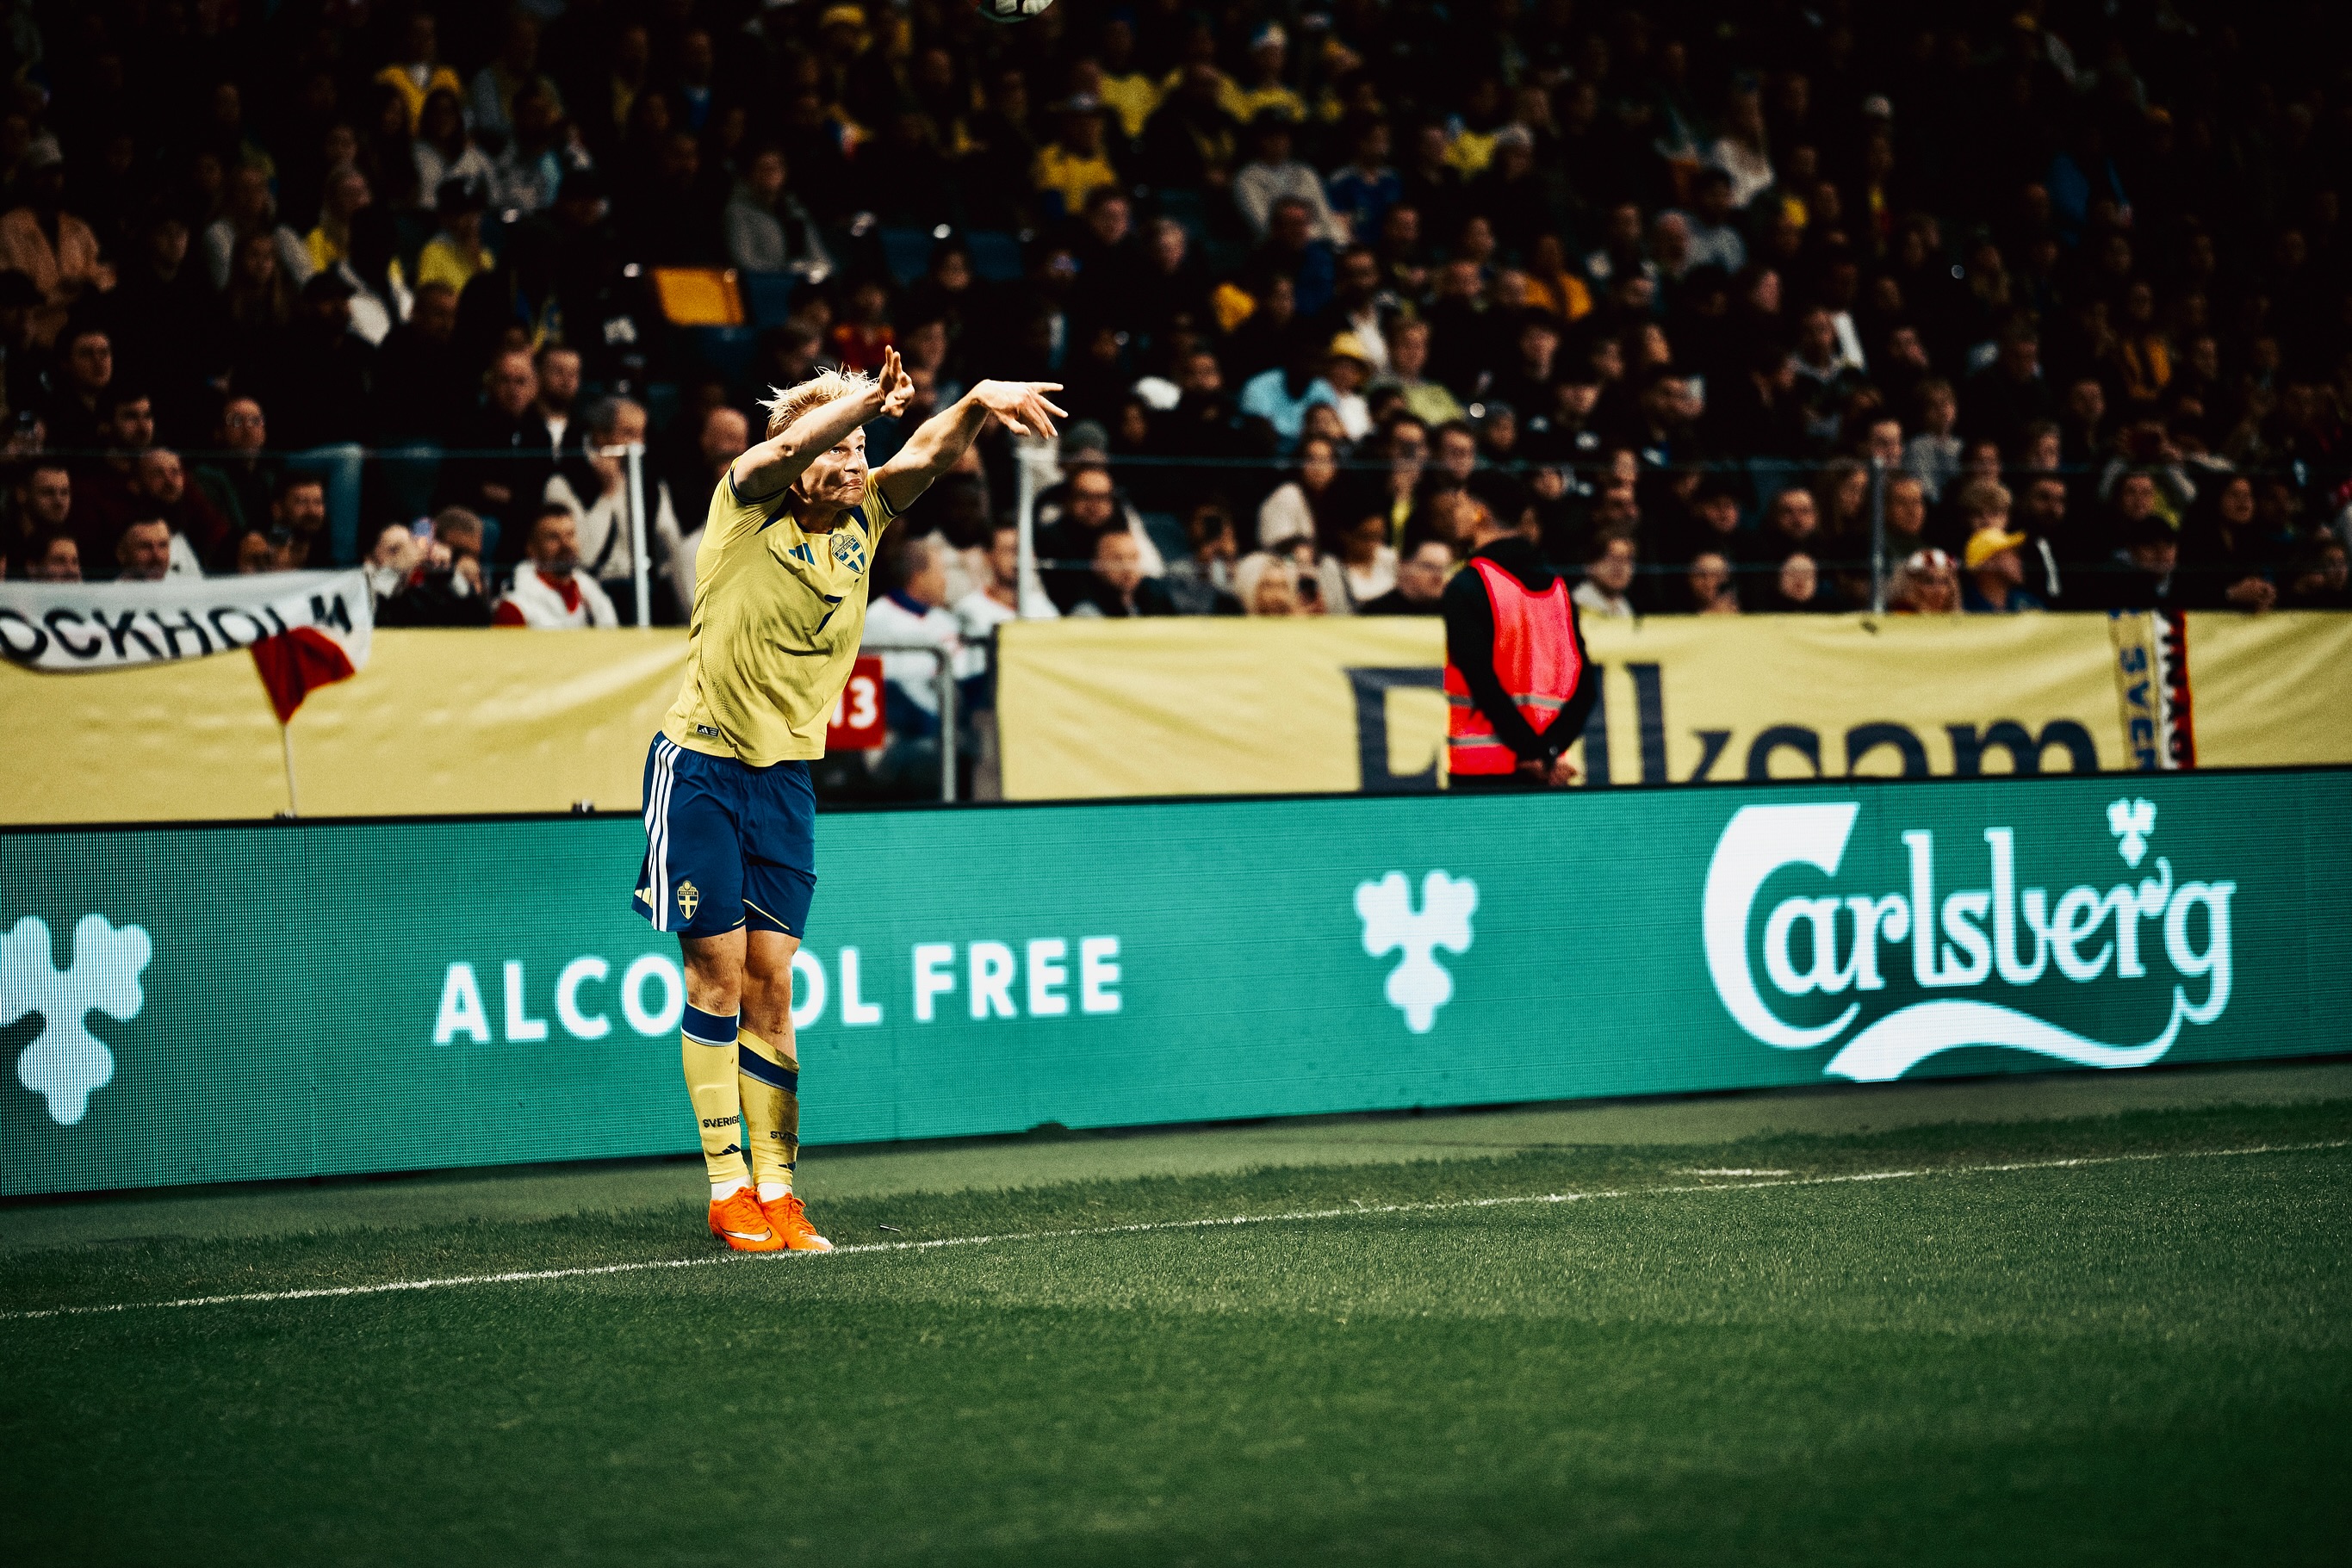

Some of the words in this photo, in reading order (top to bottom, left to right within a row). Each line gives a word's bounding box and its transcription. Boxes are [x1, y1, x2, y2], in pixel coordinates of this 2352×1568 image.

[433, 945, 882, 1045] ALCOOL
[911, 934, 1123, 1023] FREE
[1702, 801, 2237, 1050] Carlsberg
